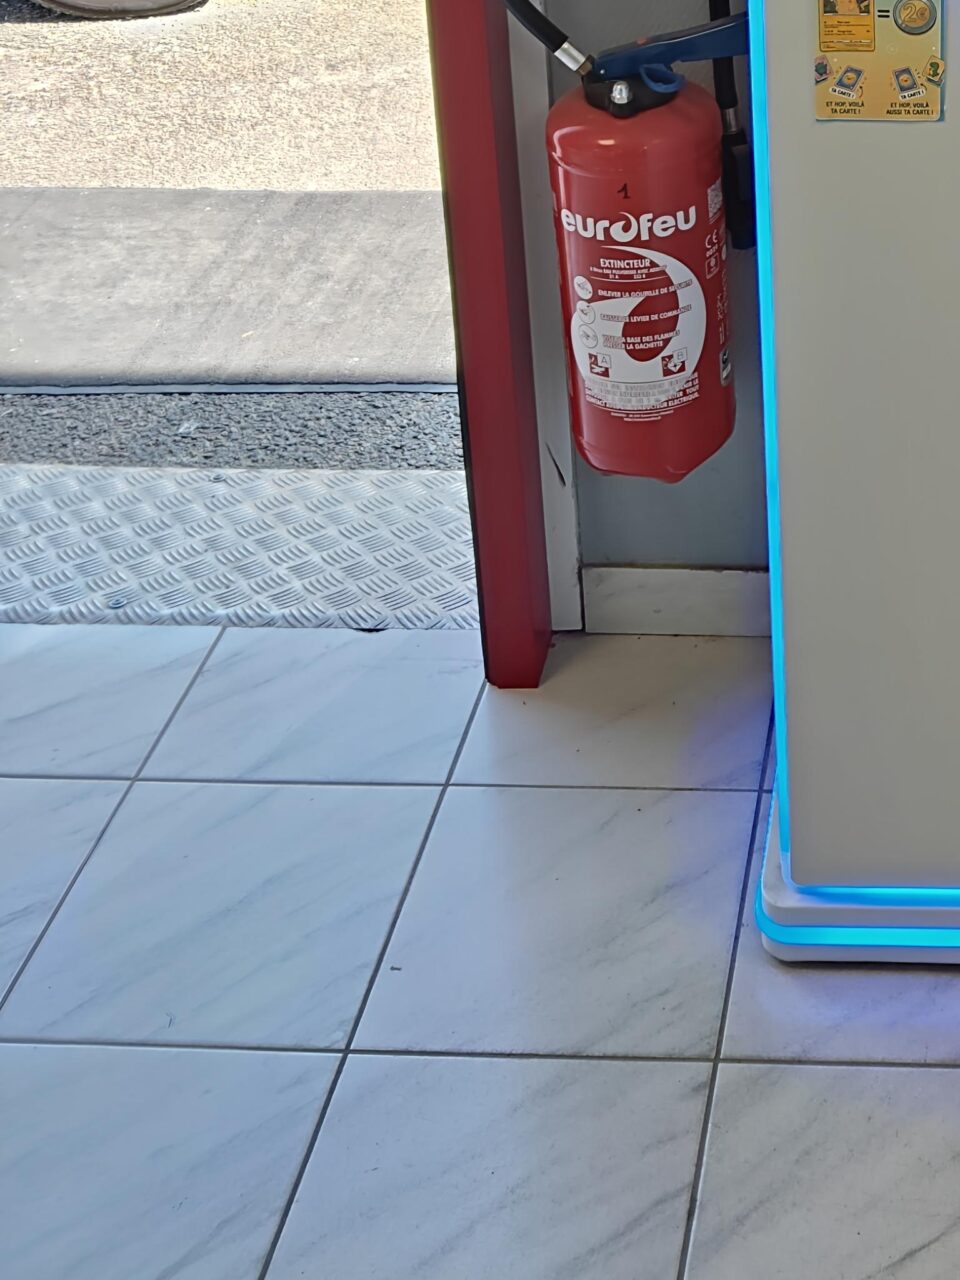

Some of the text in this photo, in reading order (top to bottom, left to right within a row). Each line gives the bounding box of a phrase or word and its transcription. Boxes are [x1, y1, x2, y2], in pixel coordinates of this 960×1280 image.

[617, 183, 630, 199] 1
[561, 206, 696, 242] eurofeu
[600, 259, 651, 268] EXTINCTEUR
[601, 356, 607, 364] A
